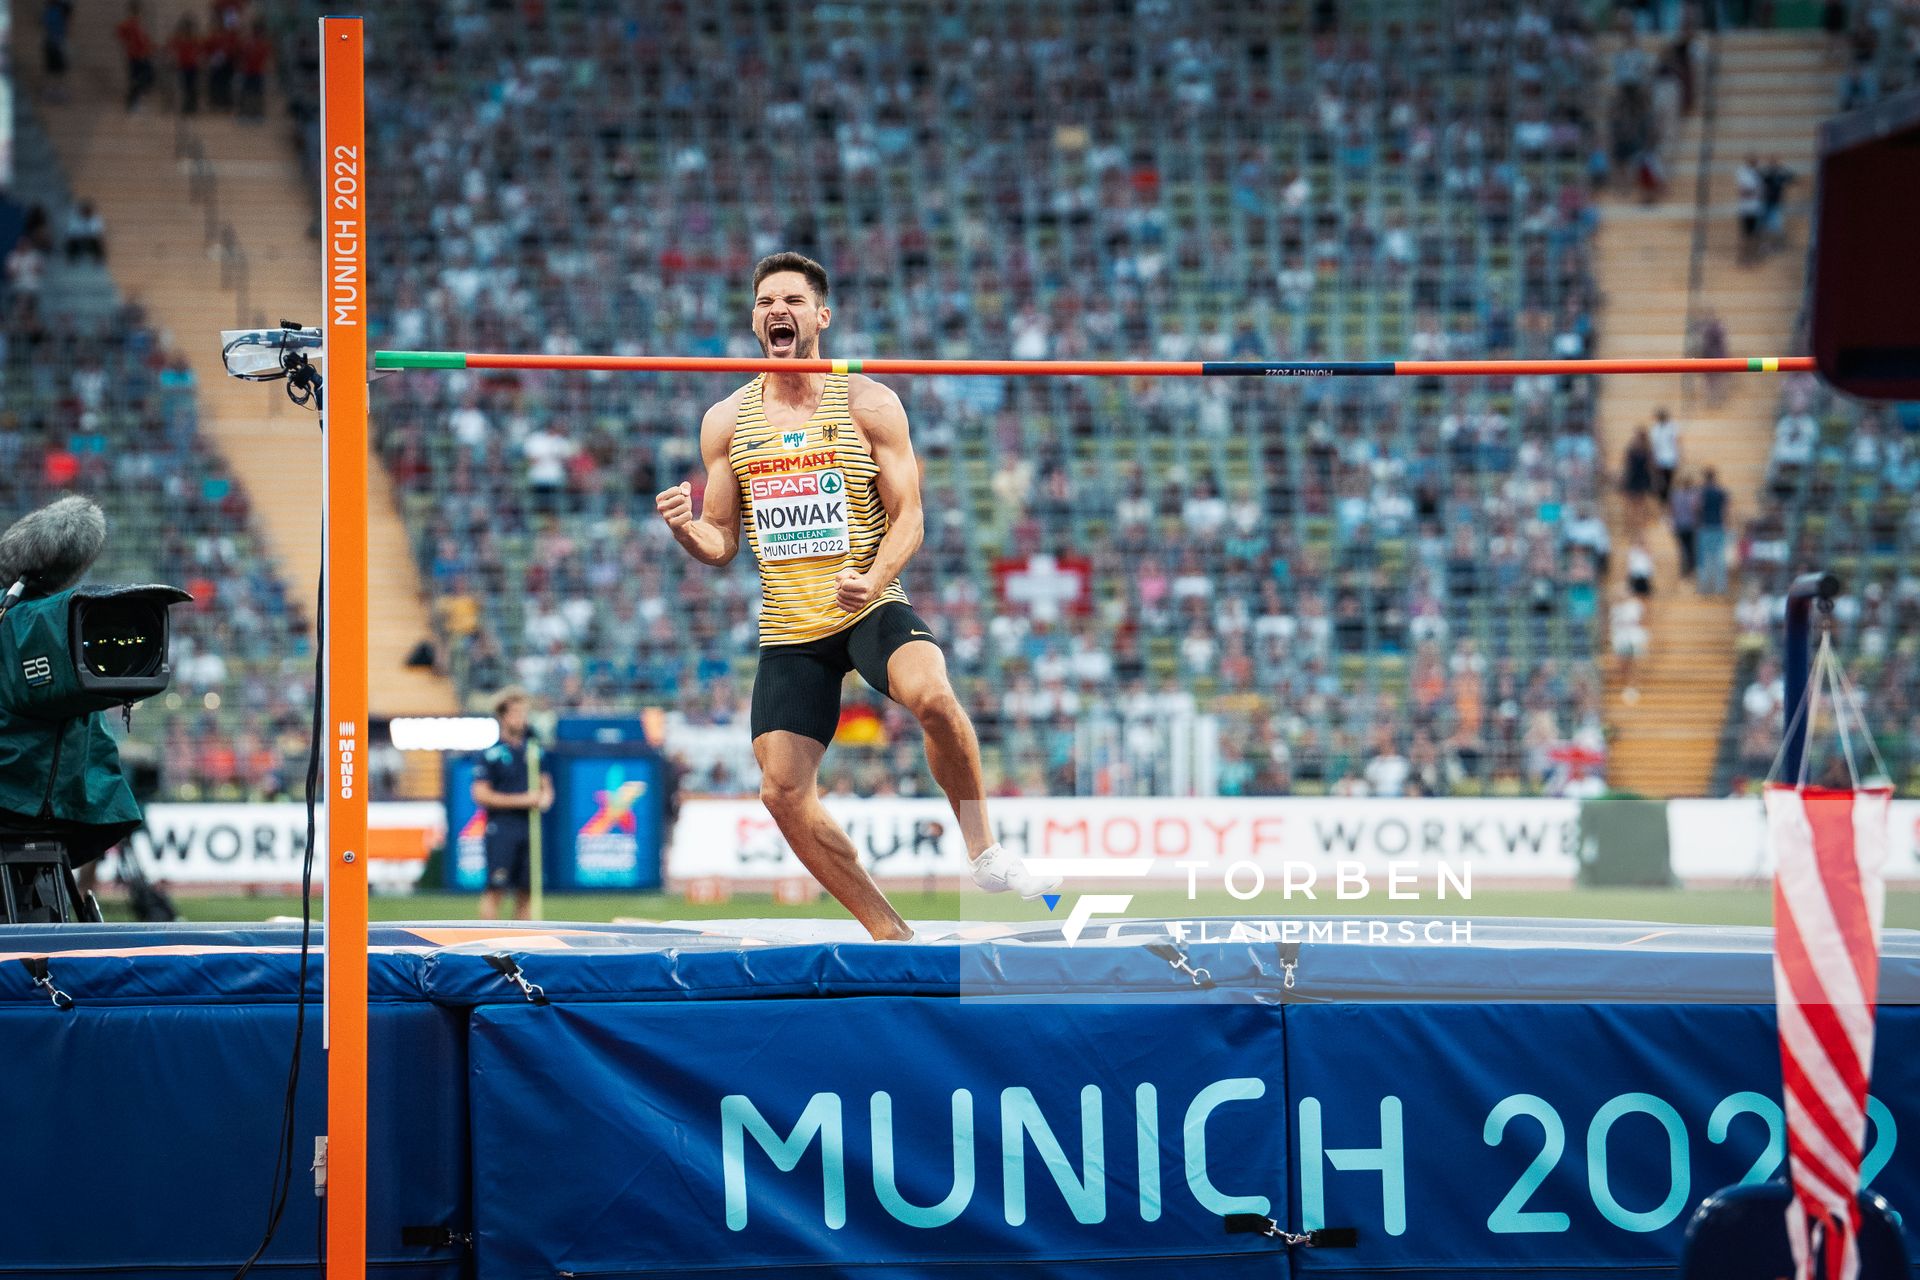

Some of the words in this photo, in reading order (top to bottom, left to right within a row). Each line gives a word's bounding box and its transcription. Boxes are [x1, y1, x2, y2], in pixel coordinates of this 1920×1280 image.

[334, 145, 358, 210] 2022
[334, 220, 358, 326] MUNICH
[748, 451, 836, 475] GERMANY
[753, 477, 817, 497] SPAR
[756, 502, 843, 530] NOWAK
[764, 543, 808, 557] MUNICH
[812, 540, 843, 553] 2022
[777, 532, 795, 541] RUN
[338, 739, 355, 799] MONDO
[1043, 818, 1283, 856] MODYF
[721, 1078, 1406, 1236] MUNICH
